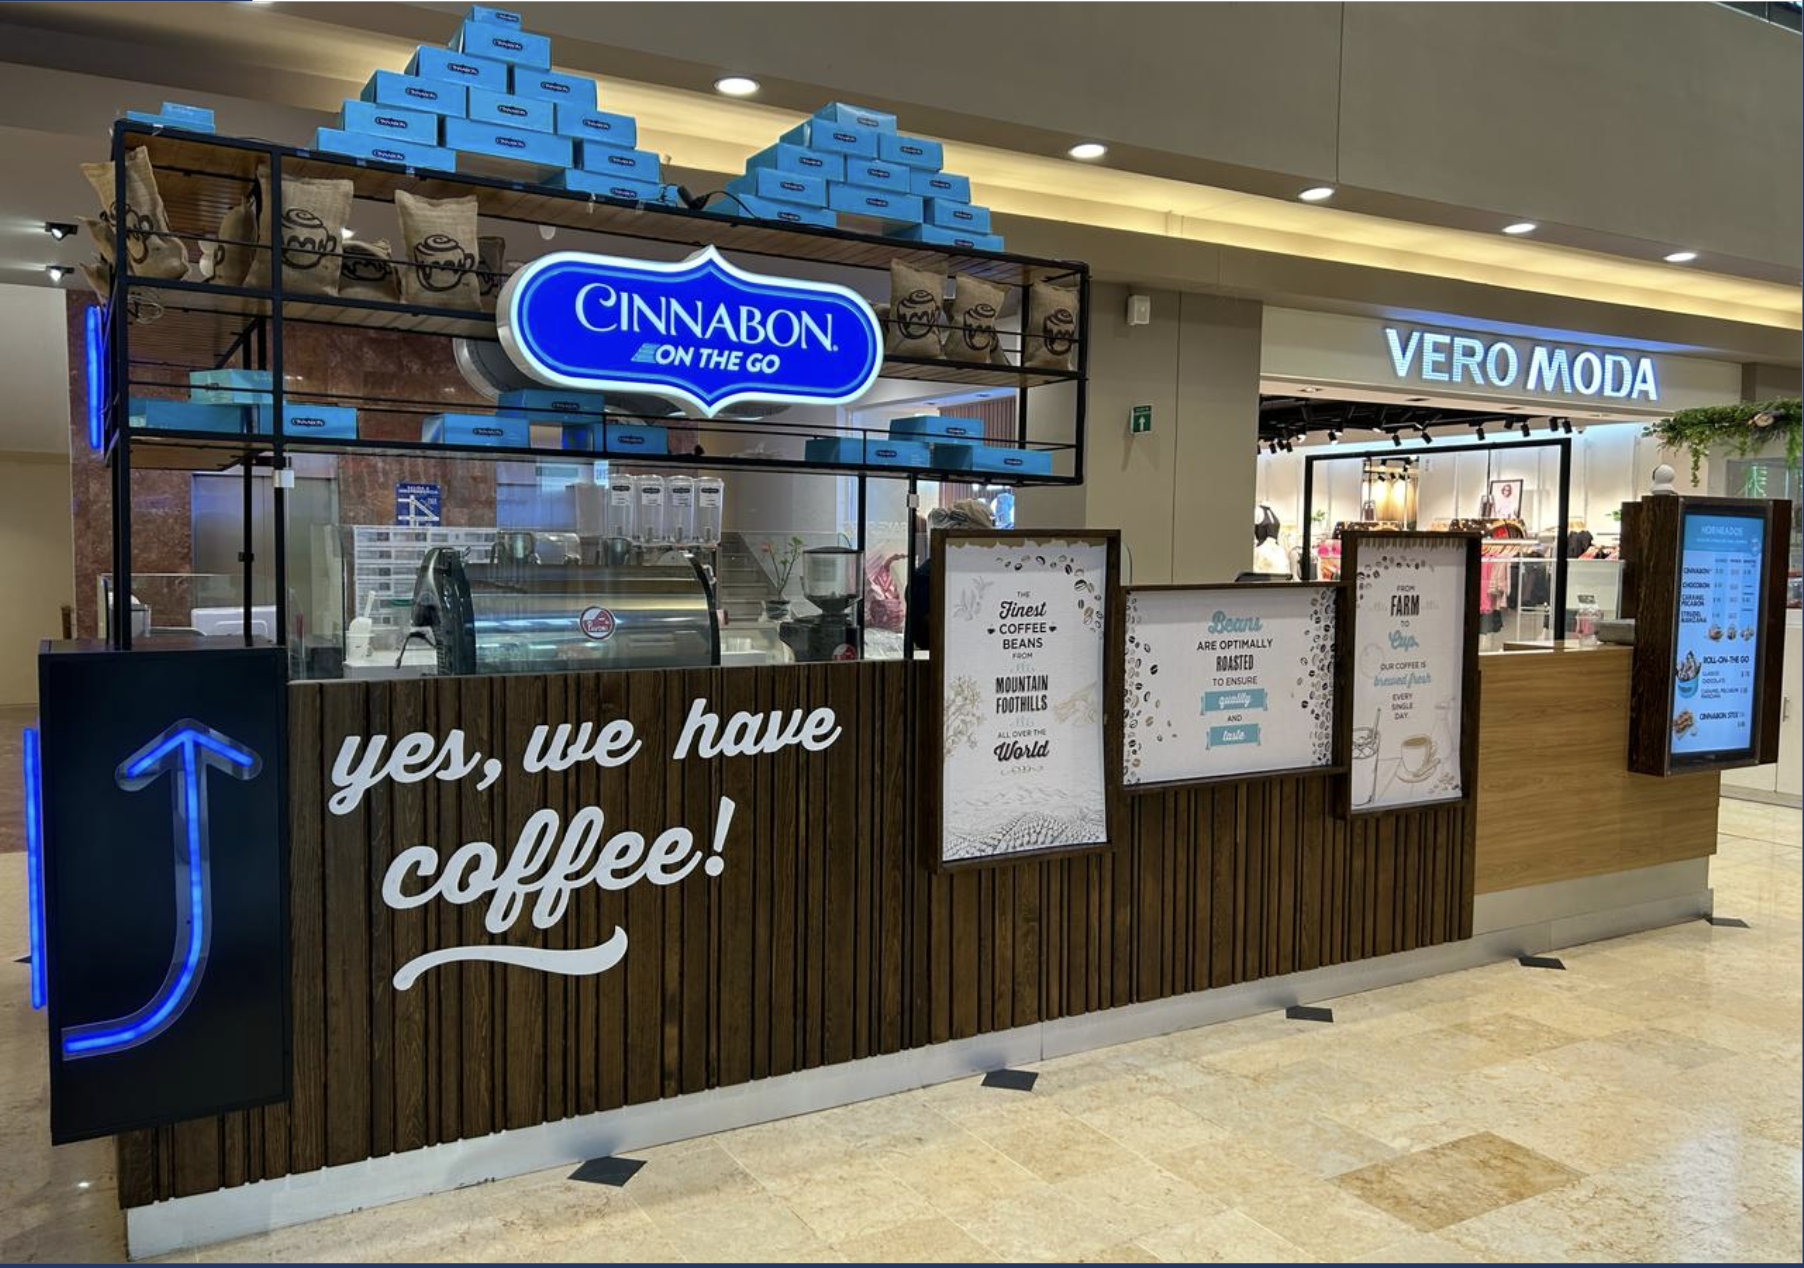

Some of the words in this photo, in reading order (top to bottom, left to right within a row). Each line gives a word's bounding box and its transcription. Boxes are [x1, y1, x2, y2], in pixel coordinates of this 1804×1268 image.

[655, 343, 695, 366] ON
[699, 347, 744, 372] THE
[745, 352, 781, 374] GO
[1385, 327, 1519, 388] VERO
[1526, 345, 1659, 401] MODA
[1017, 591, 1031, 599] THE
[999, 600, 1047, 620] Finest
[1391, 594, 1420, 617] FARM
[1207, 609, 1263, 634] Beans
[1400, 620, 1410, 628] TO
[999, 622, 1047, 635] COFFEE
[1002, 637, 1044, 650] BEANS
[1196, 640, 1217, 651] ARE
[1218, 638, 1274, 651] OPTIMALLY
[1388, 630, 1420, 652] Cup
[1012, 652, 1033, 660] FROM
[1215, 654, 1254, 672] ROASTED
[1380, 662, 1395, 671] OUR
[1395, 661, 1420, 670] COFFEE
[995, 674, 1049, 694] MOUNTAIN
[1212, 678, 1224, 687] TO
[1225, 676, 1258, 686] ENSURE
[1218, 691, 1251, 709] quality
[1392, 693, 1413, 701] EVERY
[996, 694, 1048, 714] FOOTHILLS
[1391, 702, 1413, 711] SINGLE
[1227, 714, 1243, 722] AND
[1394, 712, 1409, 720] DAY
[997, 731, 1010, 739] ALL
[1012, 730, 1031, 738] OVER
[1032, 728, 1047, 736] THE
[1222, 729, 1246, 741] taste
[328, 728, 502, 816] yes,
[521, 718, 642, 774] we
[672, 697, 842, 760] have
[993, 740, 1050, 762] World
[381, 795, 736, 934] coffee!
